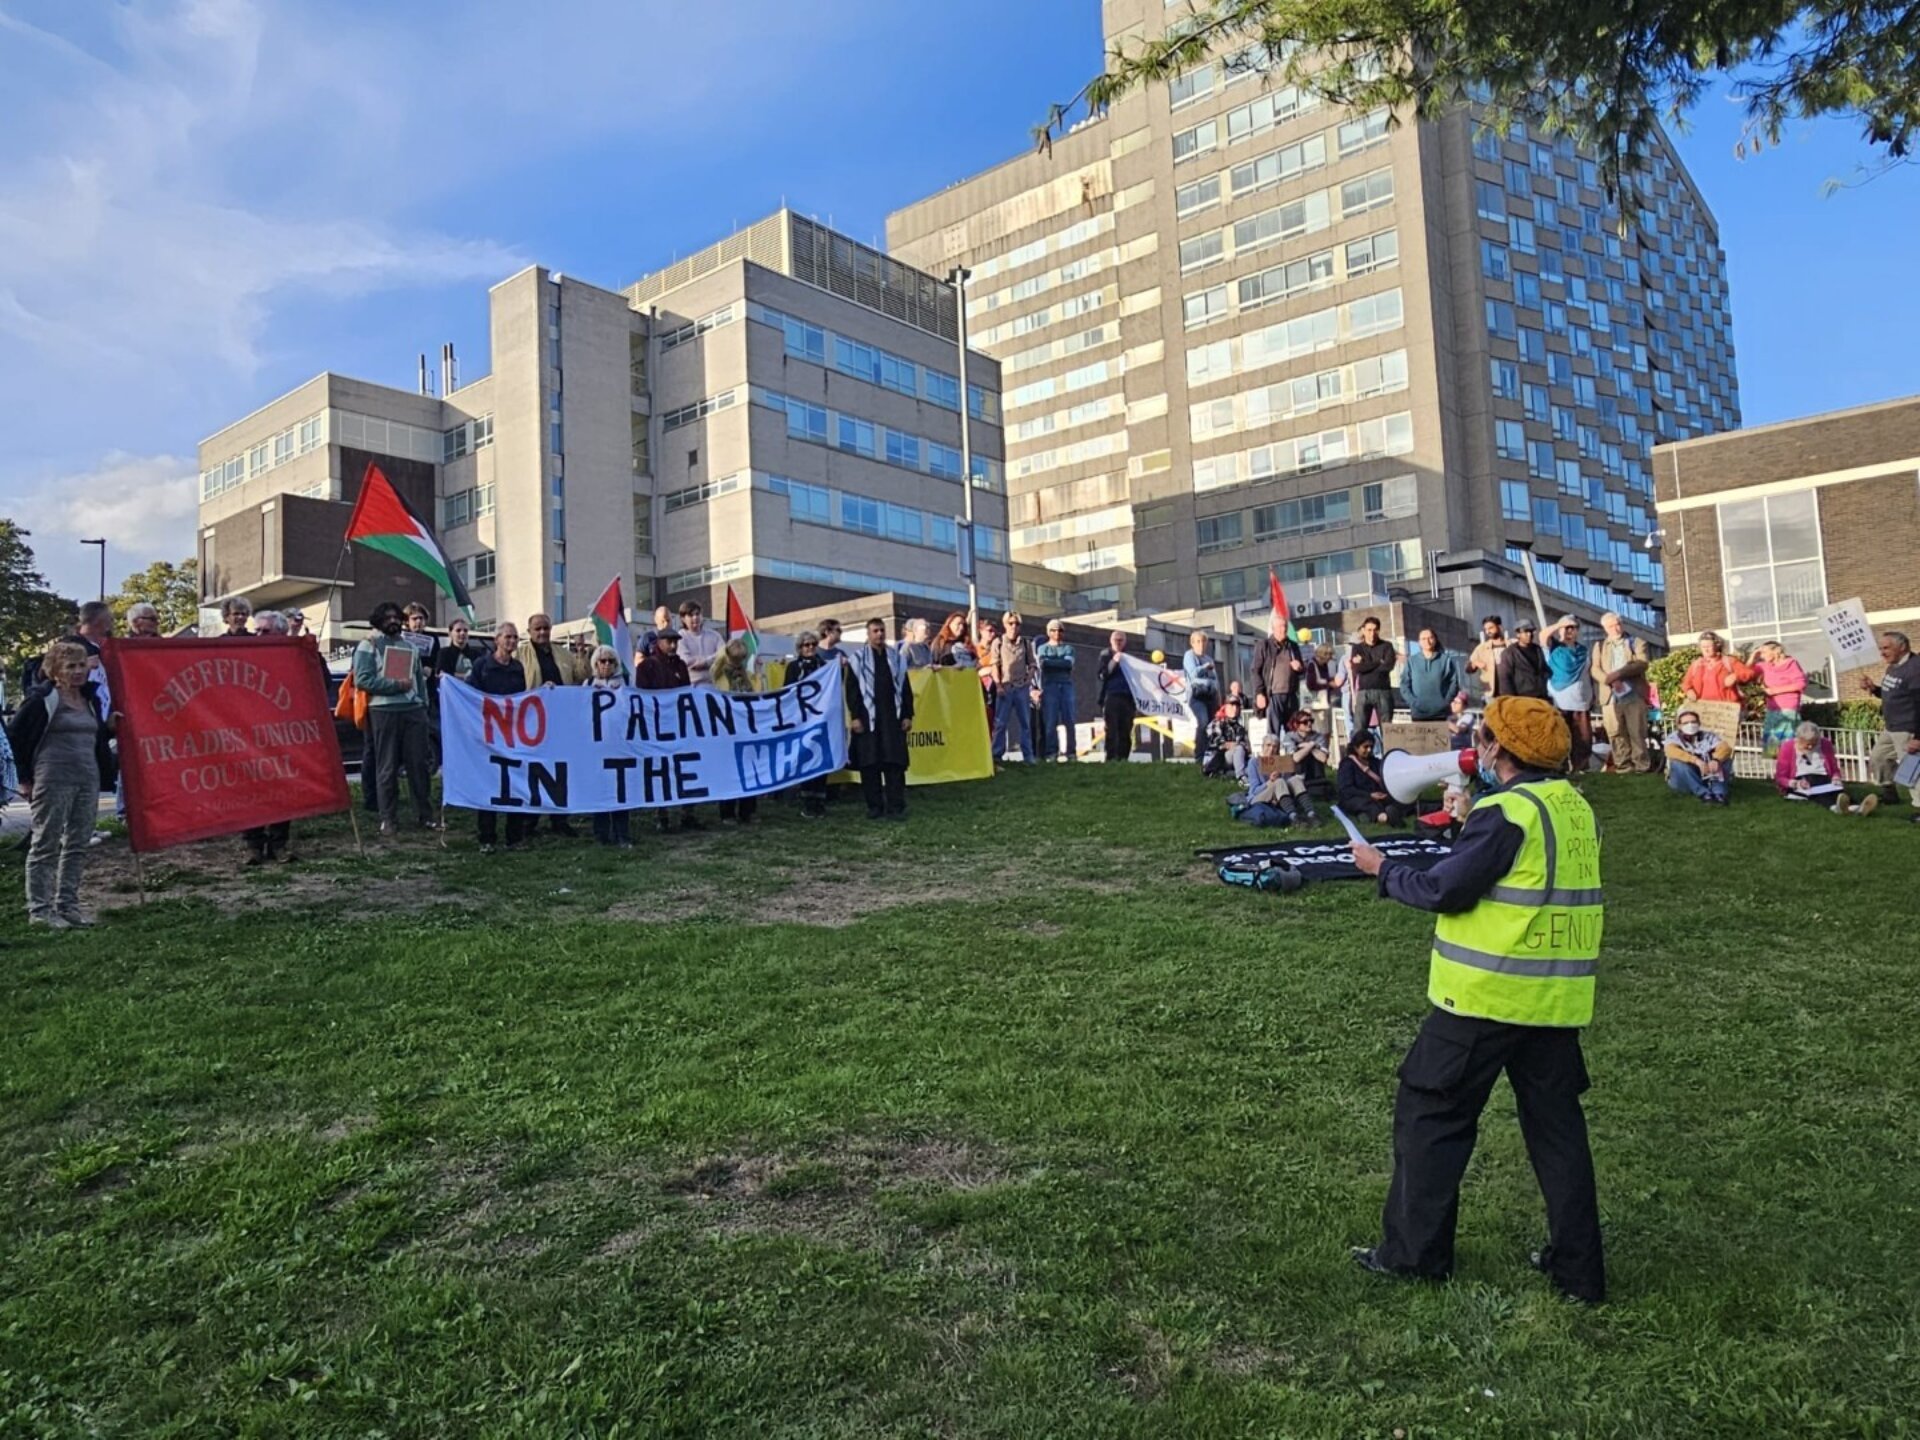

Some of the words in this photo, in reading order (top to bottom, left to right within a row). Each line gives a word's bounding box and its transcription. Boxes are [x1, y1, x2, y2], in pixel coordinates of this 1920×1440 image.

[153, 658, 292, 722] SHEFFIELD
[482, 695, 546, 748] NO
[592, 679, 823, 742] PALANTIR
[139, 727, 247, 764] TRADES
[252, 719, 320, 749] UNION
[181, 754, 298, 793] COUNCIL
[490, 755, 568, 808] IN
[604, 752, 709, 804] THE
[742, 728, 823, 790] NHS
[1567, 838, 1598, 859] PRIDE
[1578, 863, 1594, 880] IN
